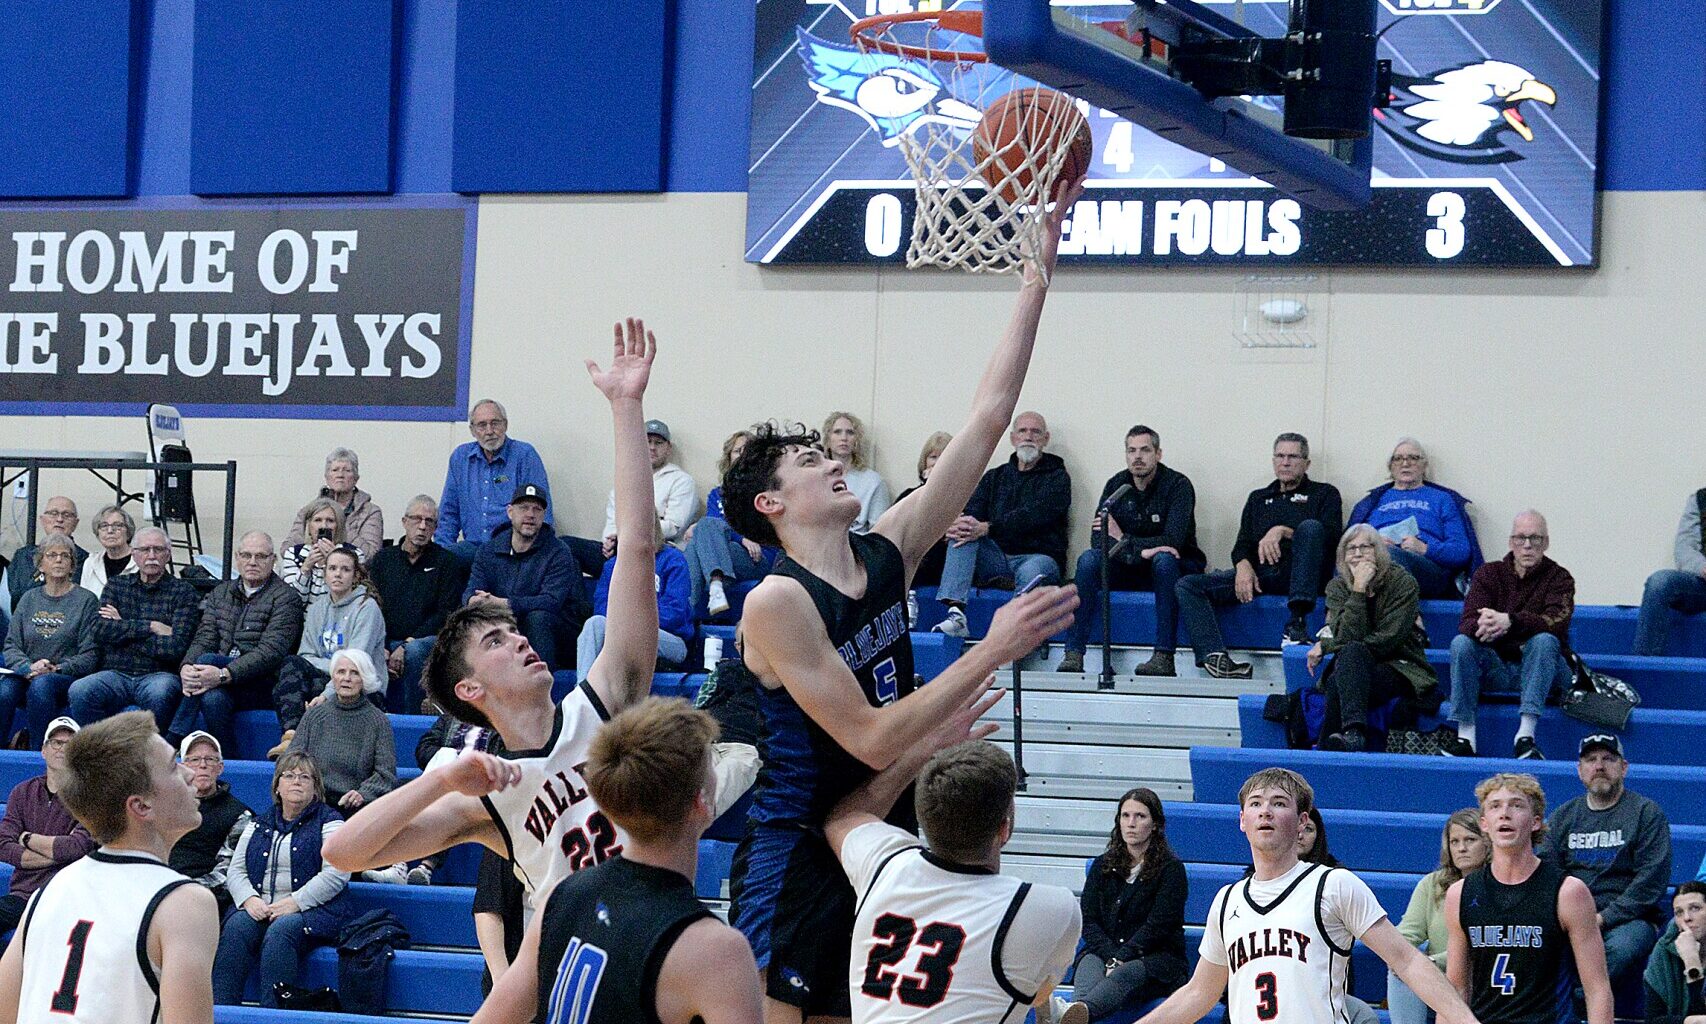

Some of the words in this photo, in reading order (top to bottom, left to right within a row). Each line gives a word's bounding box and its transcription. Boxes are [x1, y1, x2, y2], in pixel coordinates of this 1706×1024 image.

[1103, 121, 1134, 173] 4
[865, 193, 902, 257] 0
[1020, 200, 1143, 255] EAM
[1153, 199, 1301, 256] FOULS
[1425, 191, 1466, 259] 3
[9, 230, 235, 295] HOME
[257, 229, 358, 295] OF
[0, 312, 58, 374] E
[77, 312, 442, 397] BLUEJAYS
[873, 656, 899, 707] 5
[560, 809, 624, 873] 22
[1568, 829, 1625, 850] CENTRAL
[861, 911, 967, 1009] 23
[1228, 927, 1311, 976] VALLEY
[1468, 925, 1543, 948] BLUEJAYS
[49, 918, 95, 1016] 1
[545, 935, 608, 1024] 10
[1490, 953, 1516, 996] 4
[1255, 971, 1278, 1022] 3
